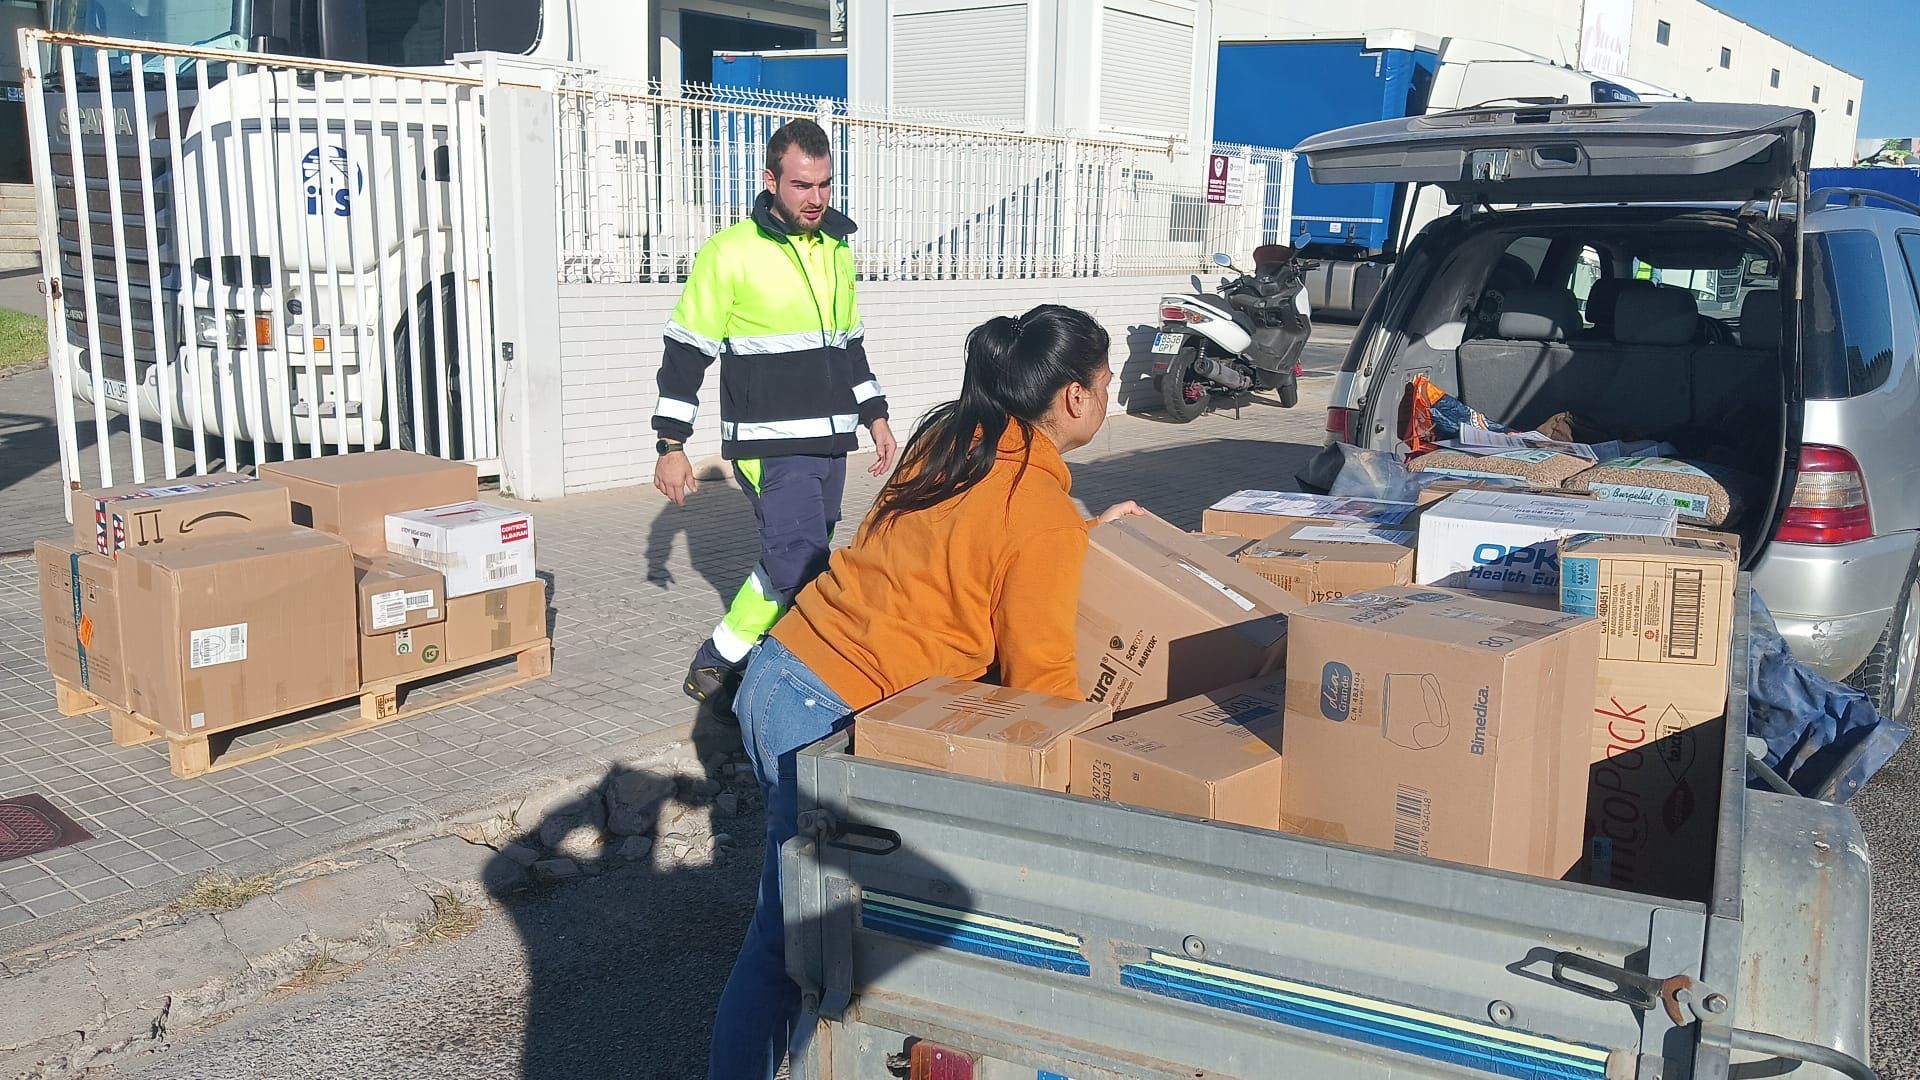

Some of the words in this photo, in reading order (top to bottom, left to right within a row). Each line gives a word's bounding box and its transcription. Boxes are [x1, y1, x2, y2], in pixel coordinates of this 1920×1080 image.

[1158, 343, 1175, 352] GPY
[501, 522, 527, 533] CONTIENE
[1468, 565, 1526, 583] Health
[1599, 585, 1609, 617] 460451.1
[1338, 675, 1350, 713] Grande
[1350, 703, 1358, 721] C.N.
[1092, 764, 1102, 785] 207
[1421, 798, 1432, 832] 834048
